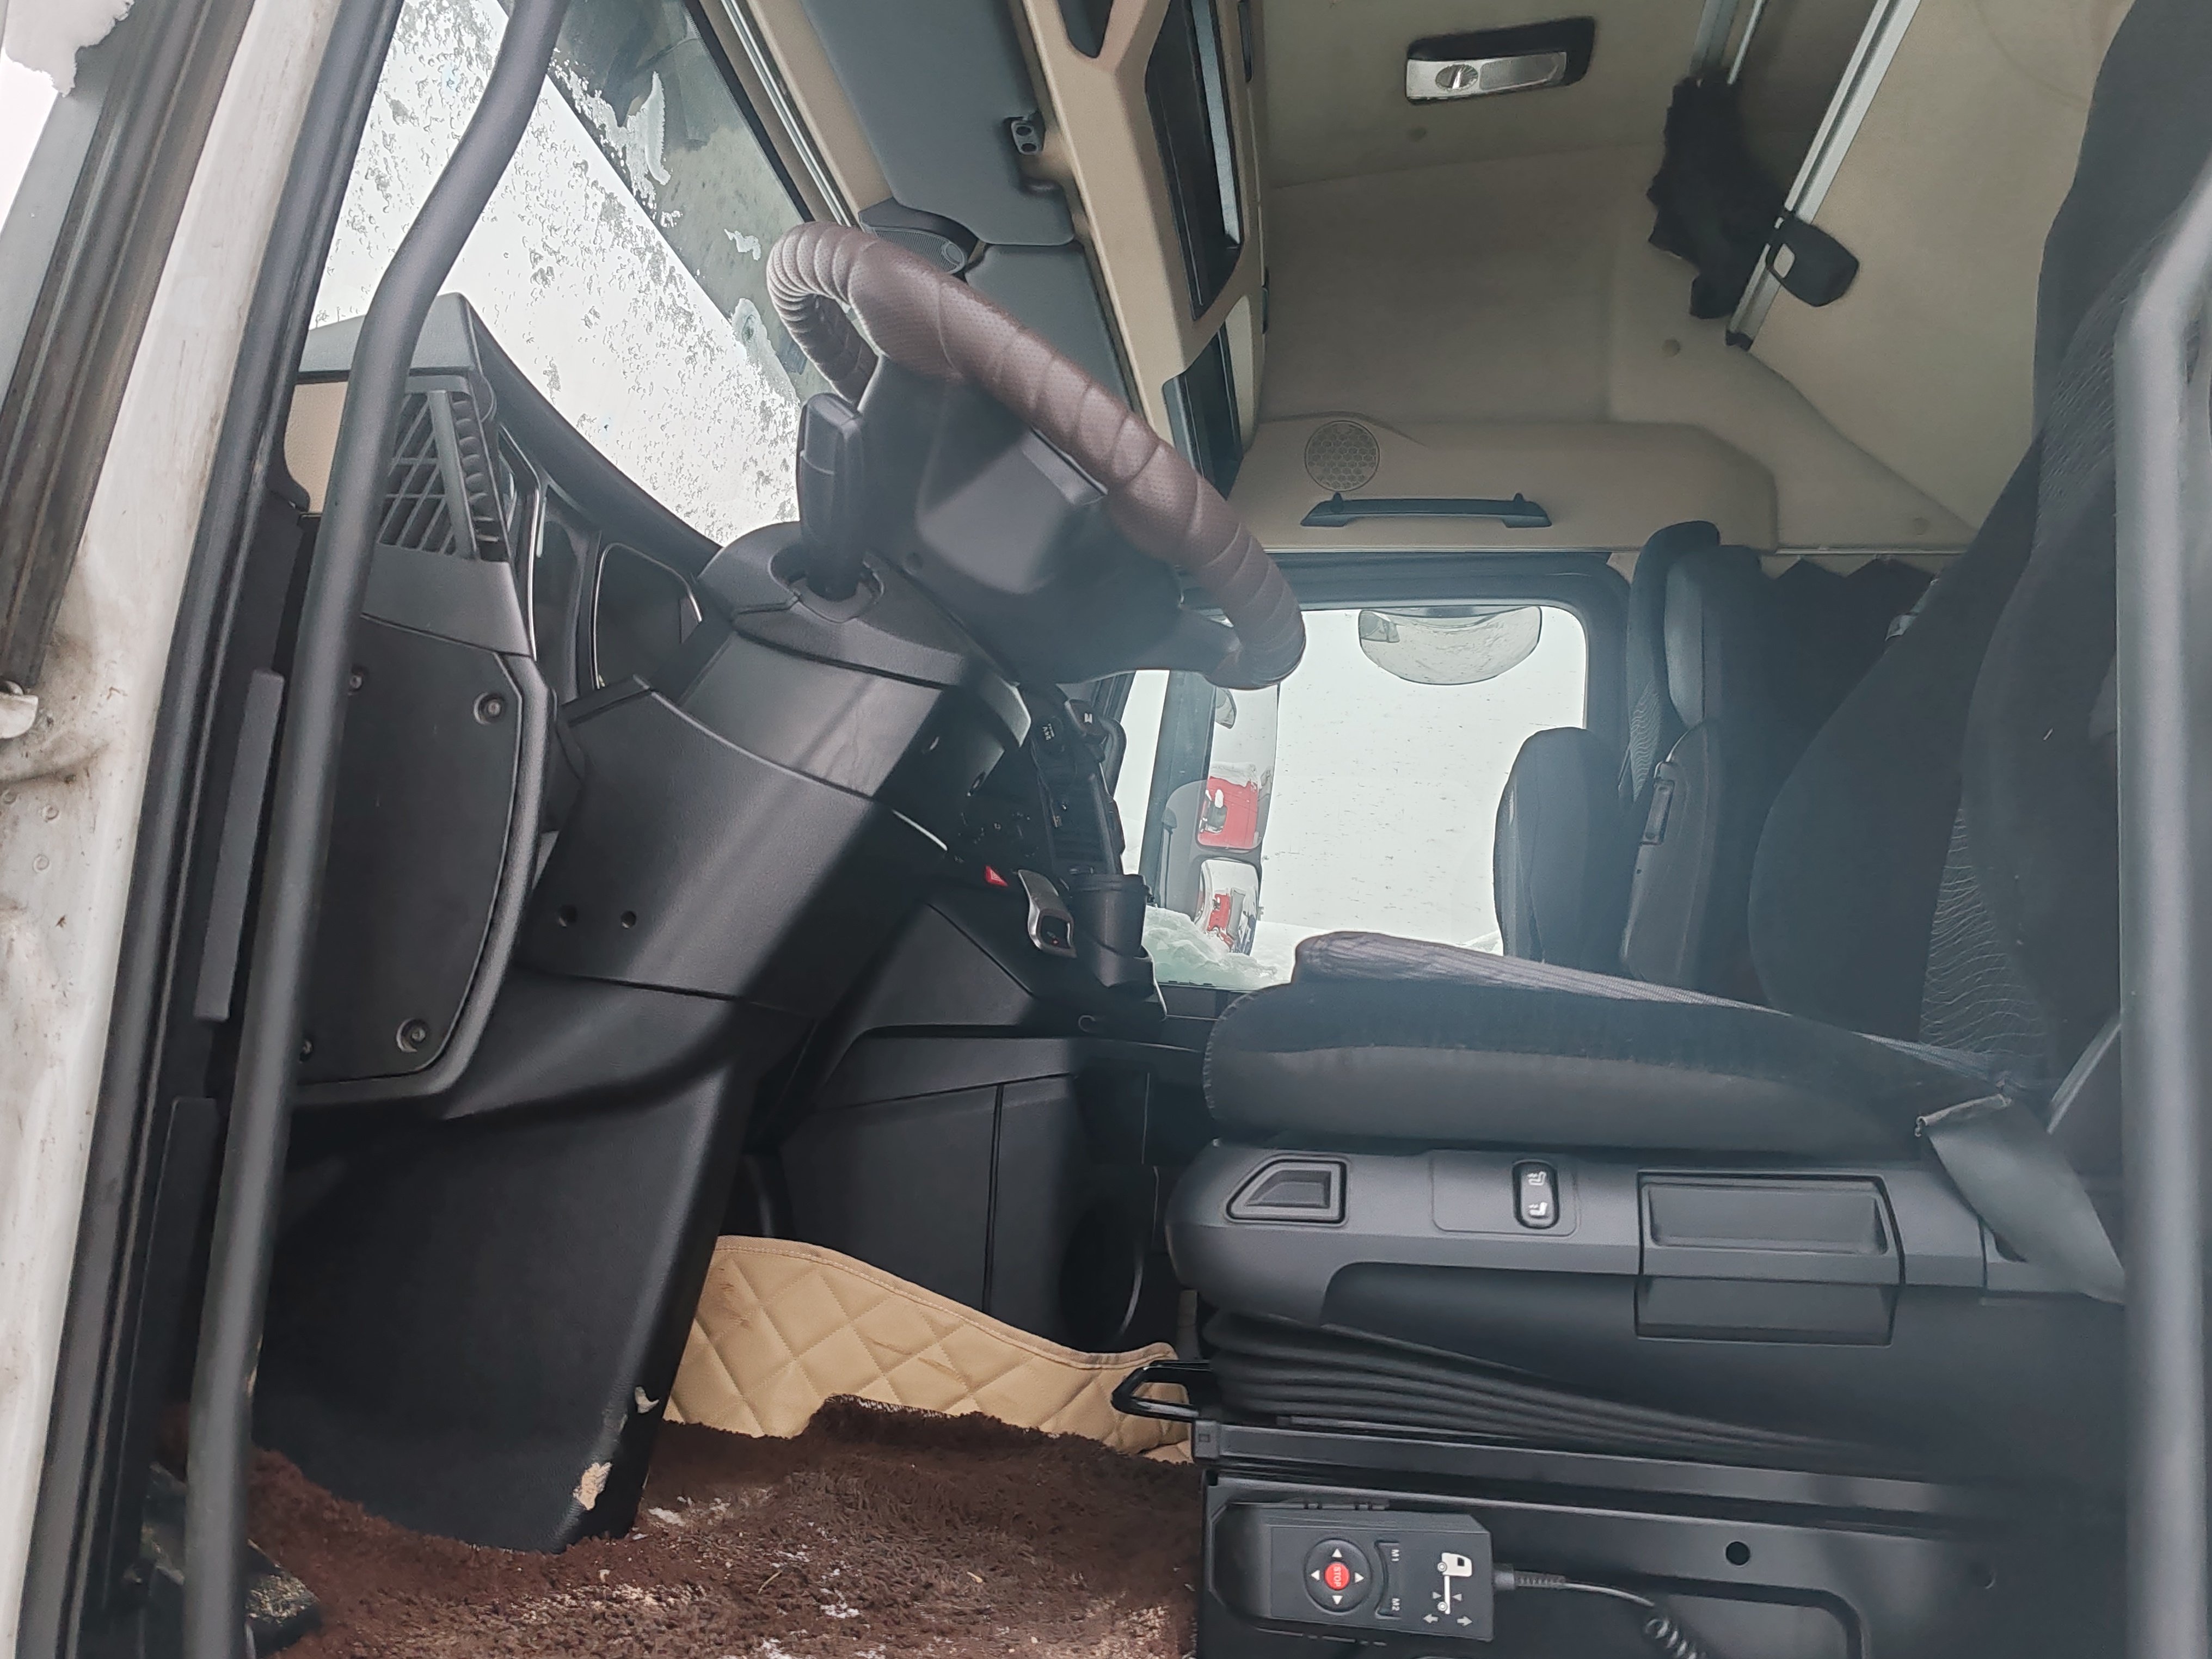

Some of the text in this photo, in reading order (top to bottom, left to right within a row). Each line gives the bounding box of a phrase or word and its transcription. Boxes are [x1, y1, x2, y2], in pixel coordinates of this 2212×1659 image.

[1391, 1549, 1399, 1562] M1
[1334, 1566, 1342, 1587] STOP
[1392, 1598, 1400, 1611] M2
